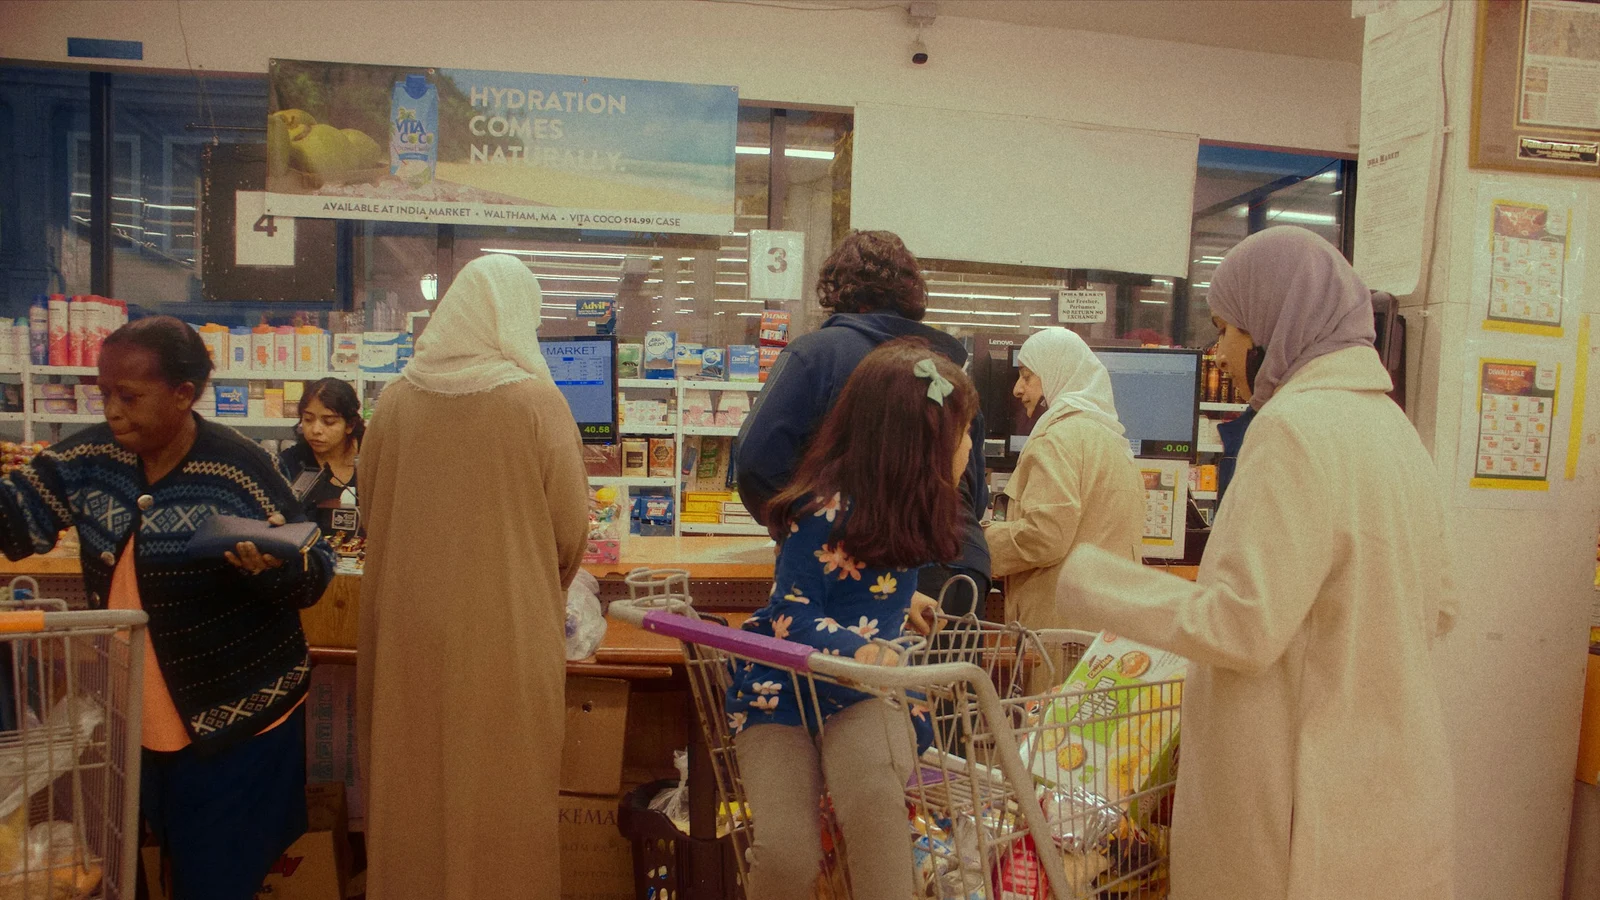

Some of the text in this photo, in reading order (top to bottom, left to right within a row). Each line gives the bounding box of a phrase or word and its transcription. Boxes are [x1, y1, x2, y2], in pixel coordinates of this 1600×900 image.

[470, 84, 627, 115] HYDRATION
[395, 119, 427, 135] VITA
[468, 115, 565, 140] COMES
[469, 143, 626, 172] NATURALLY.
[322, 202, 380, 213] AVAILABLE
[381, 205, 395, 214] AT
[396, 206, 427, 216] INDIA
[428, 207, 472, 218] MARKET
[483, 209, 540, 222] WALTHAM,
[540, 213, 557, 222] MA
[569, 213, 591, 223] VITA
[592, 215, 622, 225] COCO
[253, 214, 278, 237] 4
[766, 247, 788, 274] 3
[580, 301, 606, 310] Advil
[762, 312, 788, 320] TYLENOL
[988, 338, 1014, 346] Lenovo
[546, 346, 598, 355] MARKET
[1487, 368, 1510, 376] DIWALI
[584, 425, 610, 434] 40.58
[1162, 444, 1189, 453] -0.00
[558, 807, 617, 826] KEMA
